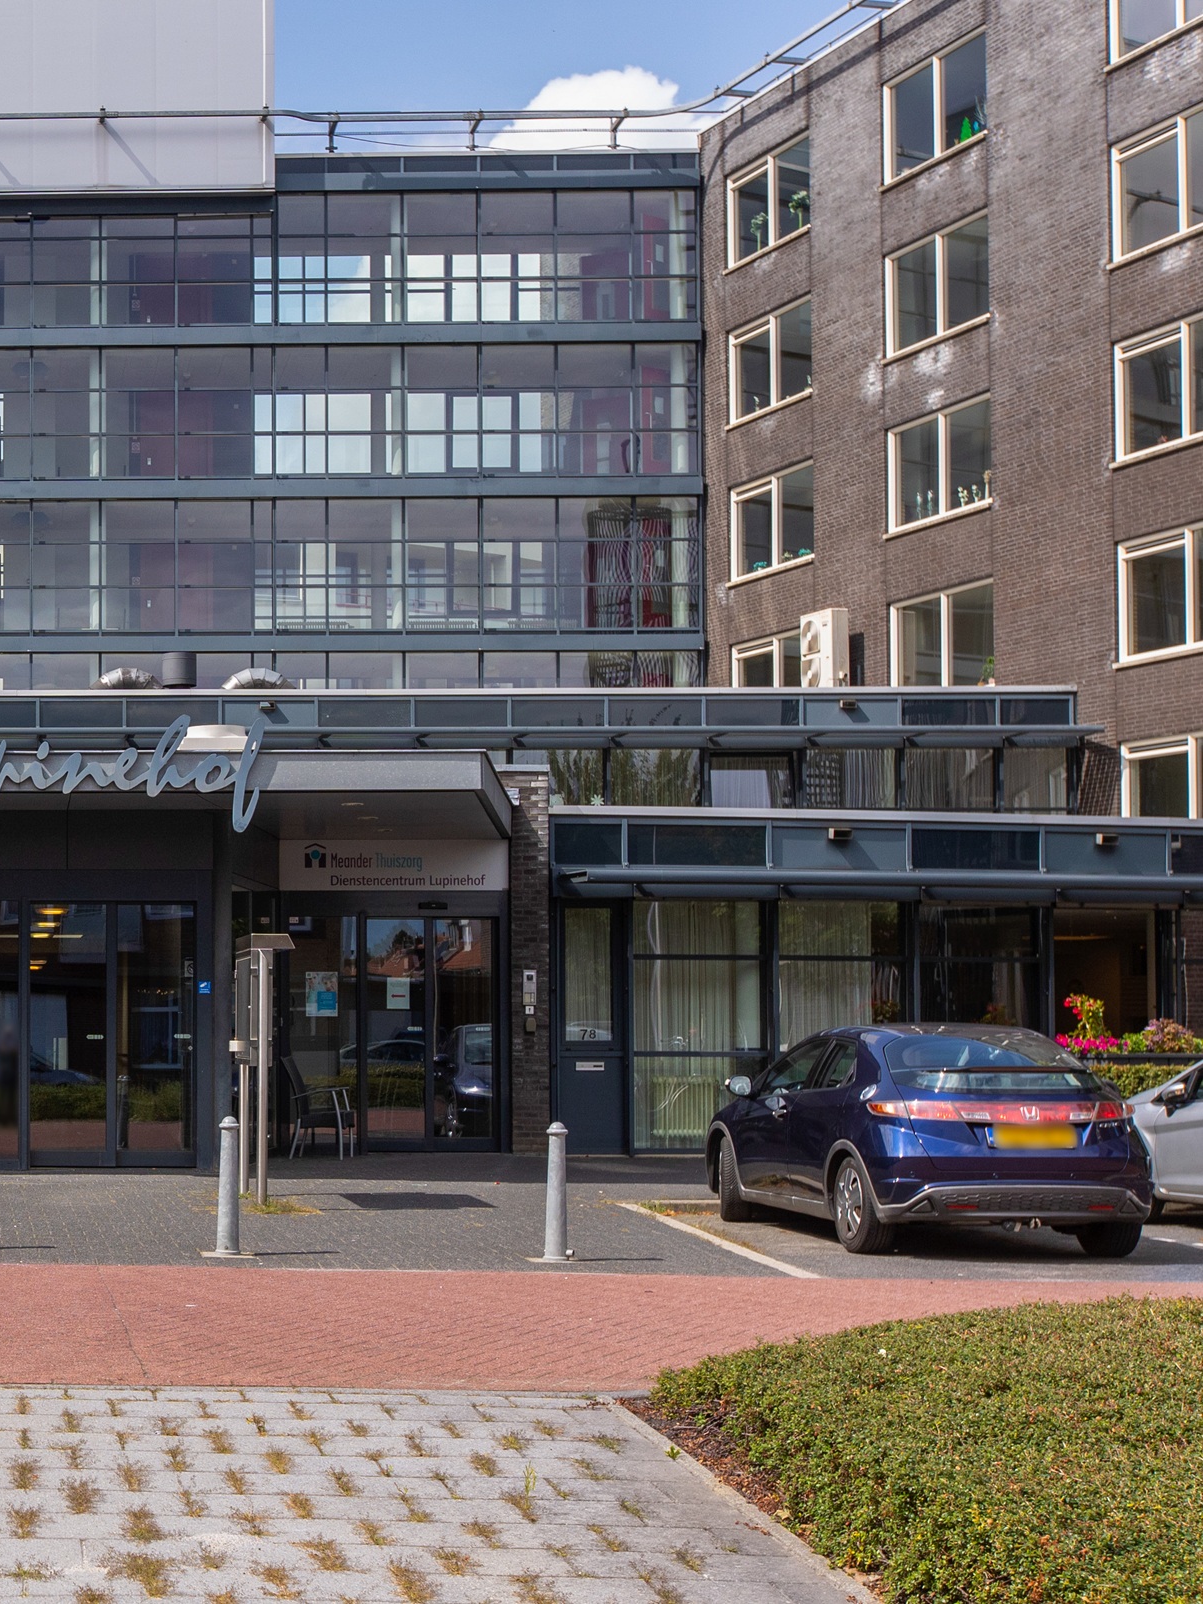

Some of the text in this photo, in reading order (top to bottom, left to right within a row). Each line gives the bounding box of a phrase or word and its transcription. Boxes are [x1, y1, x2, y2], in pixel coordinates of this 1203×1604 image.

[330, 852, 423, 872] Meander Thuiszorg
[330, 874, 486, 889] Dienstencentrum Lupinehof
[580, 1029, 597, 1041] 78
